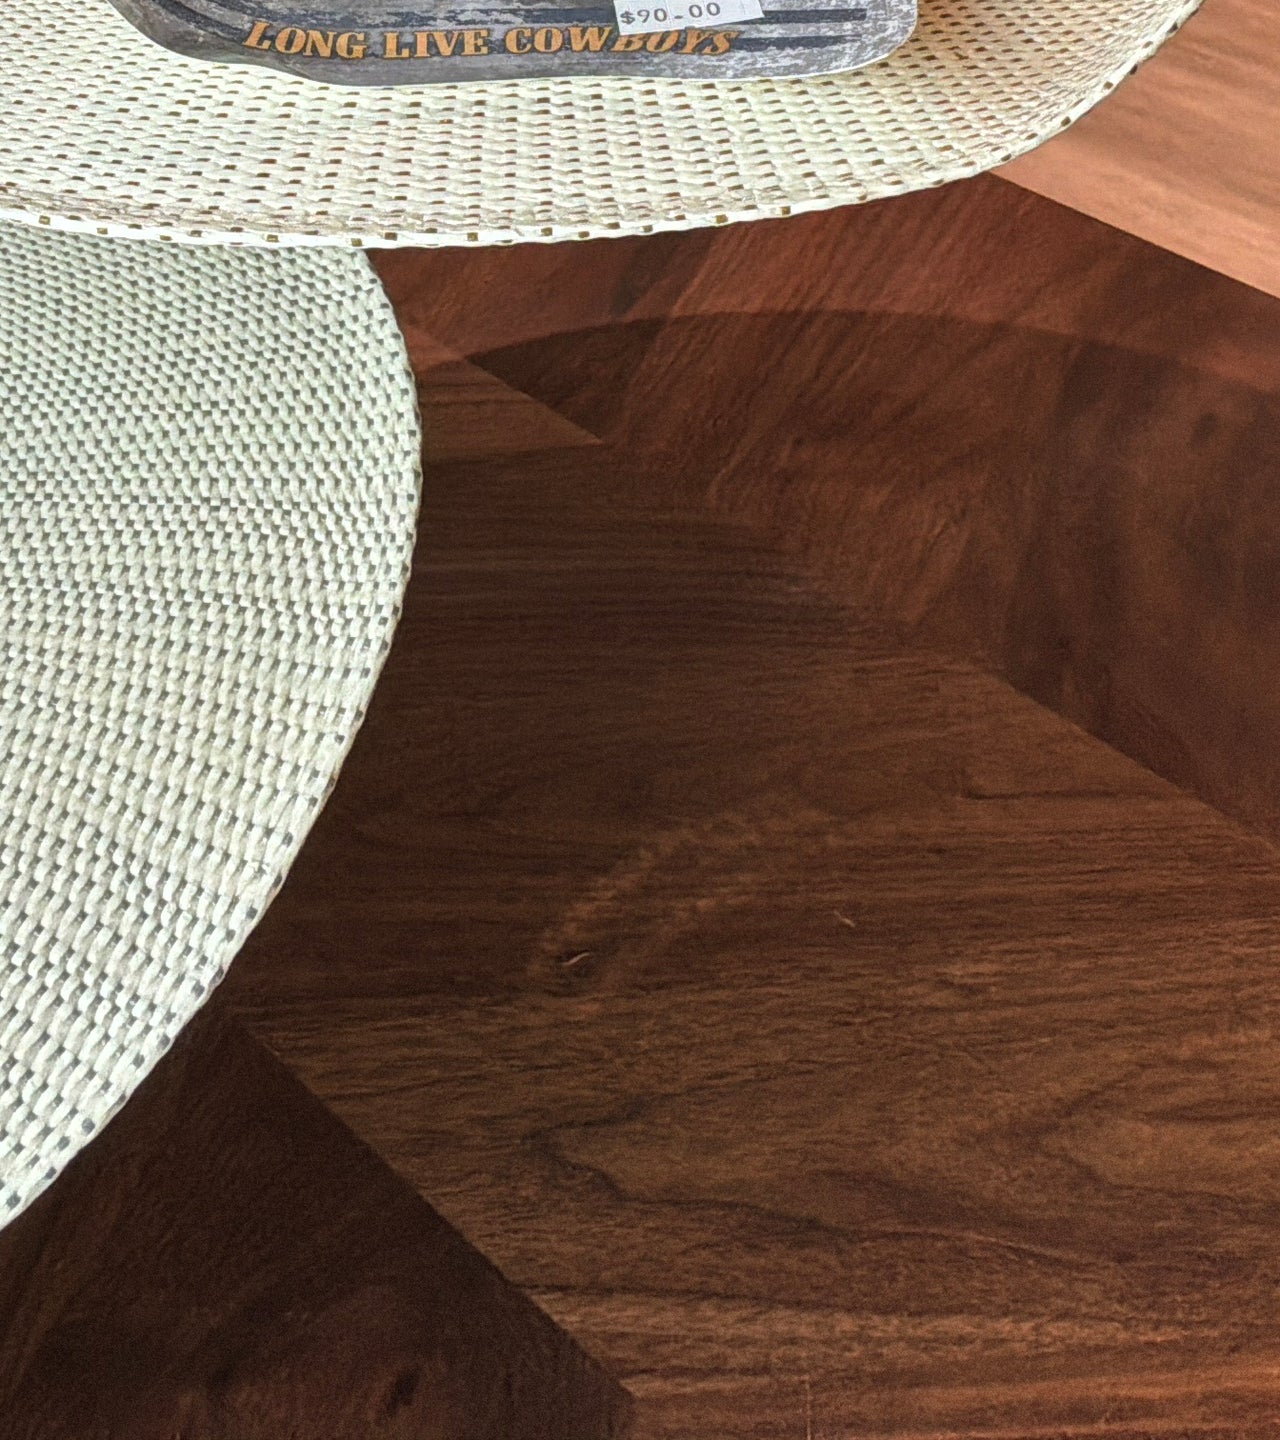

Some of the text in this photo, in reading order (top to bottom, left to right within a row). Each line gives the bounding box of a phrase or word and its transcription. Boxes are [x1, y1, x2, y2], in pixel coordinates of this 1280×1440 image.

[242, 21, 740, 59] LONG LIVE COWBOYS
